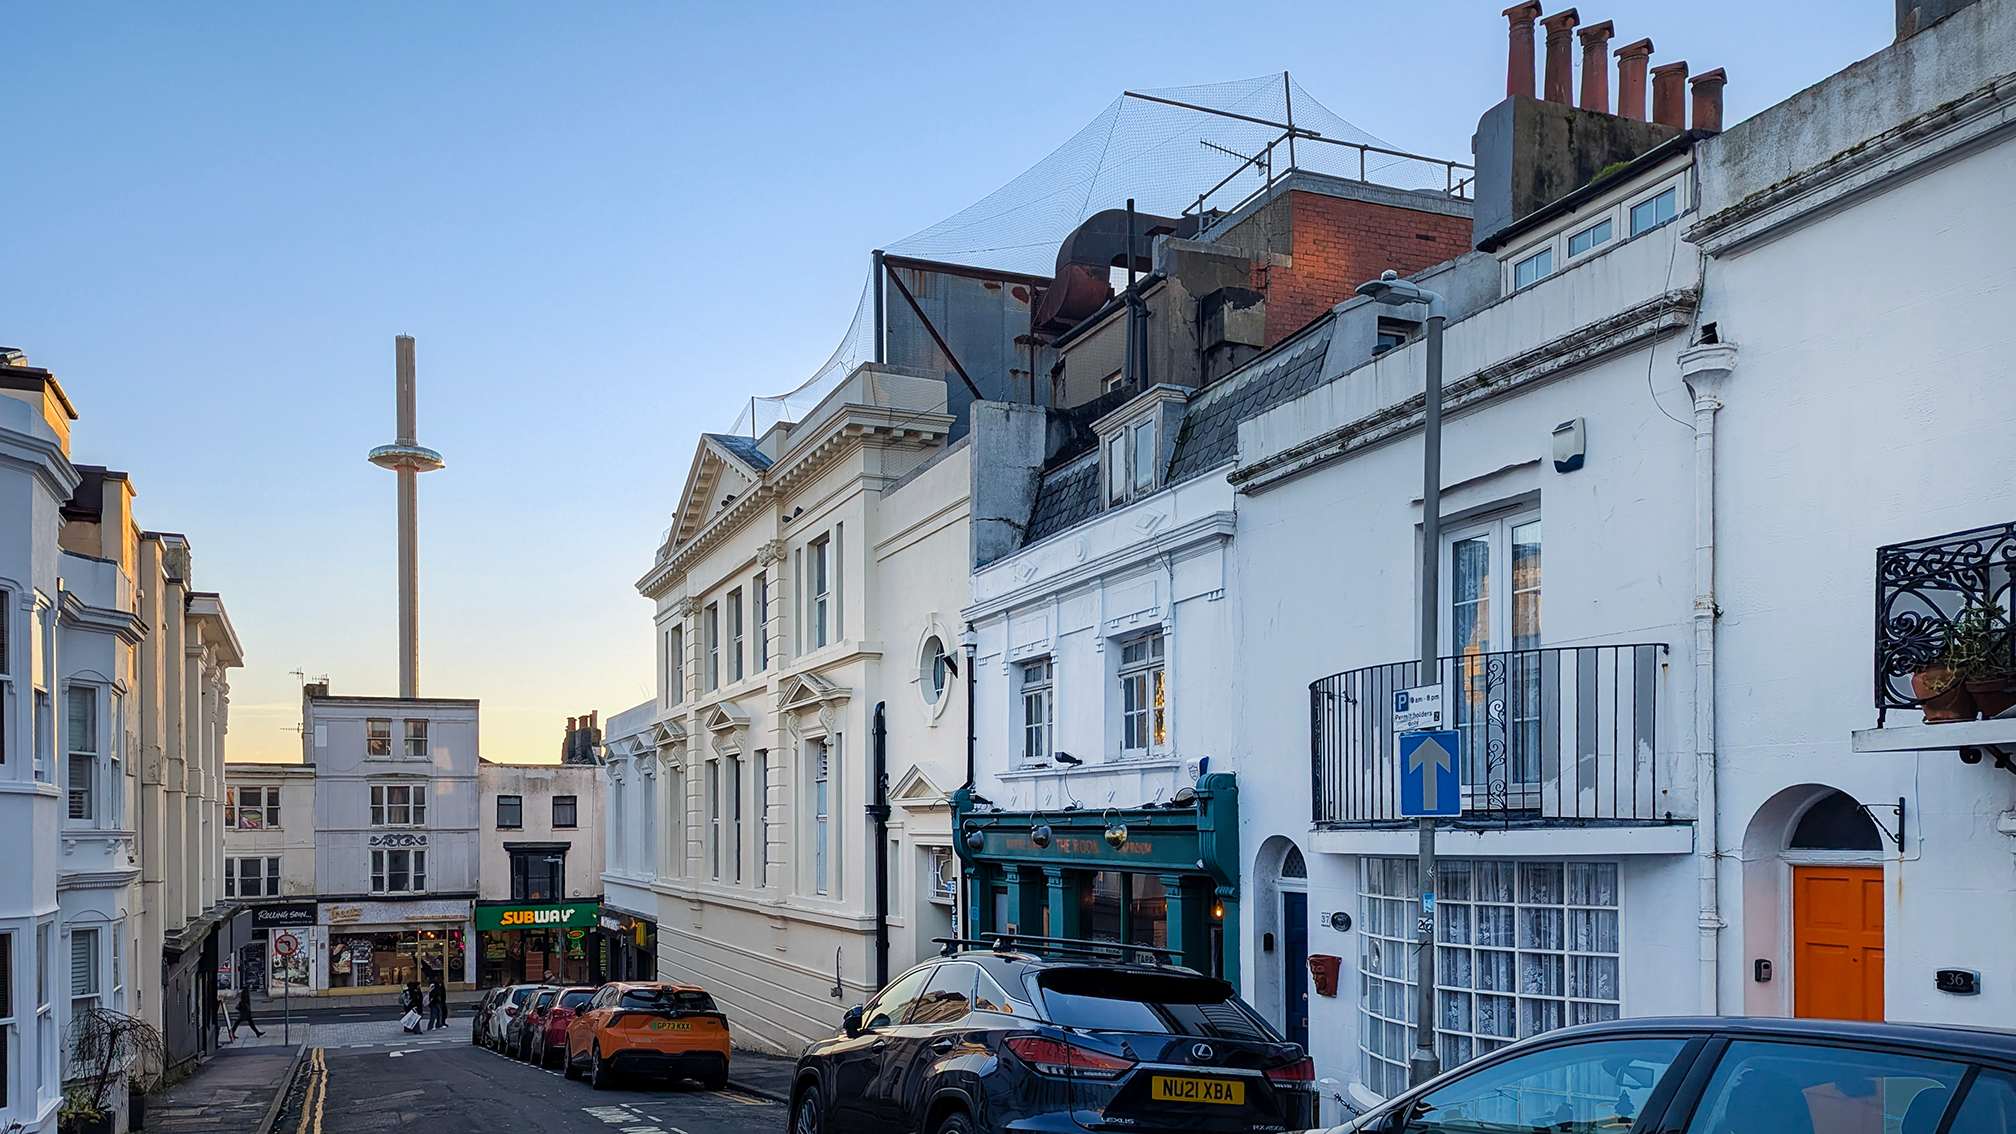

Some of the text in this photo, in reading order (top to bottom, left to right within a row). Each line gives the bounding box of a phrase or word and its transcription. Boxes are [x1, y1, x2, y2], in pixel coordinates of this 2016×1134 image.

[500, 909, 576, 925] SUBWAY
[1946, 972, 1964, 986] 36
[1162, 1079, 1233, 1101] NU21 XBA
[1101, 1116, 1135, 1125] LEXUS
